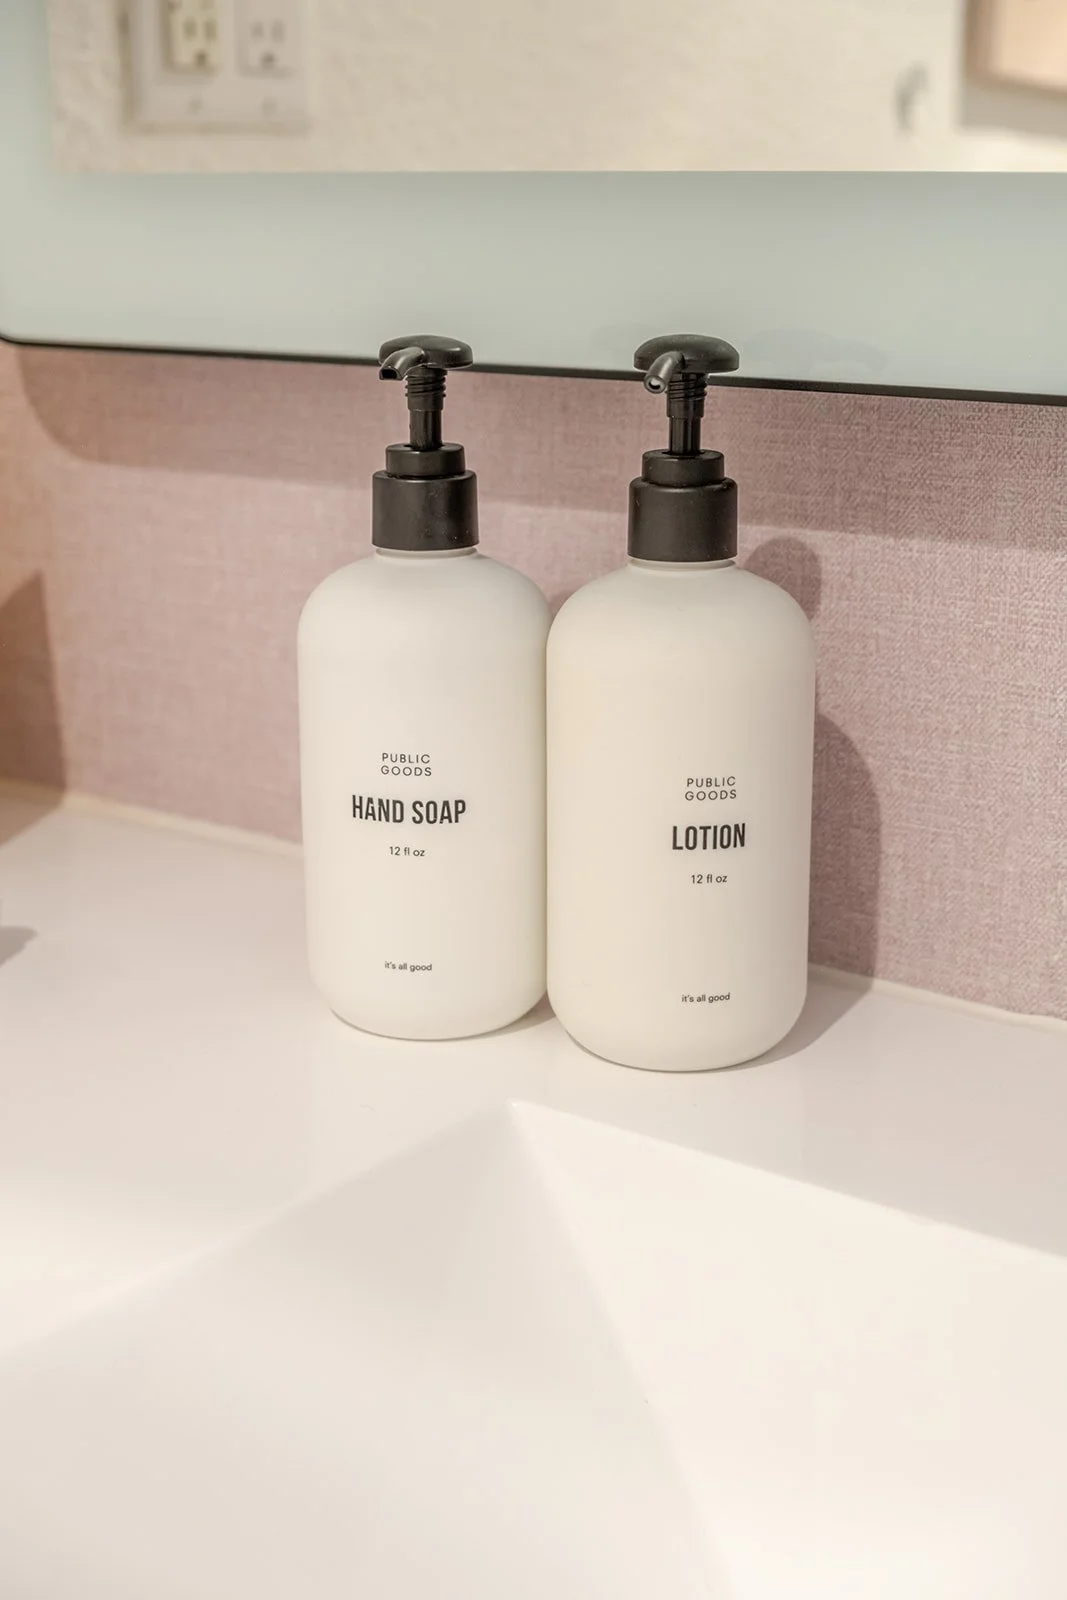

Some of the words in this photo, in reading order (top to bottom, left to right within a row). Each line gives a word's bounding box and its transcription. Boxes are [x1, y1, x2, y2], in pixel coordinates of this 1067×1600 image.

[381, 752, 431, 764] PUBLIC
[380, 765, 432, 777] GOODS
[686, 776, 736, 788] PUBLIC
[684, 789, 737, 801] GOODS
[352, 794, 405, 823] HAND
[411, 799, 467, 824] SOAP
[671, 822, 746, 851] LOTION
[389, 846, 401, 856] 12
[404, 846, 411, 856] fl
[412, 849, 426, 857] oz
[691, 874, 704, 885] 12
[706, 873, 713, 884] fl
[715, 875, 728, 884] oz
[384, 960, 396, 970] it's
[398, 961, 408, 971] all
[409, 961, 433, 973] good
[681, 993, 695, 1003] it's
[696, 993, 707, 1003] all
[708, 991, 731, 1004] good
